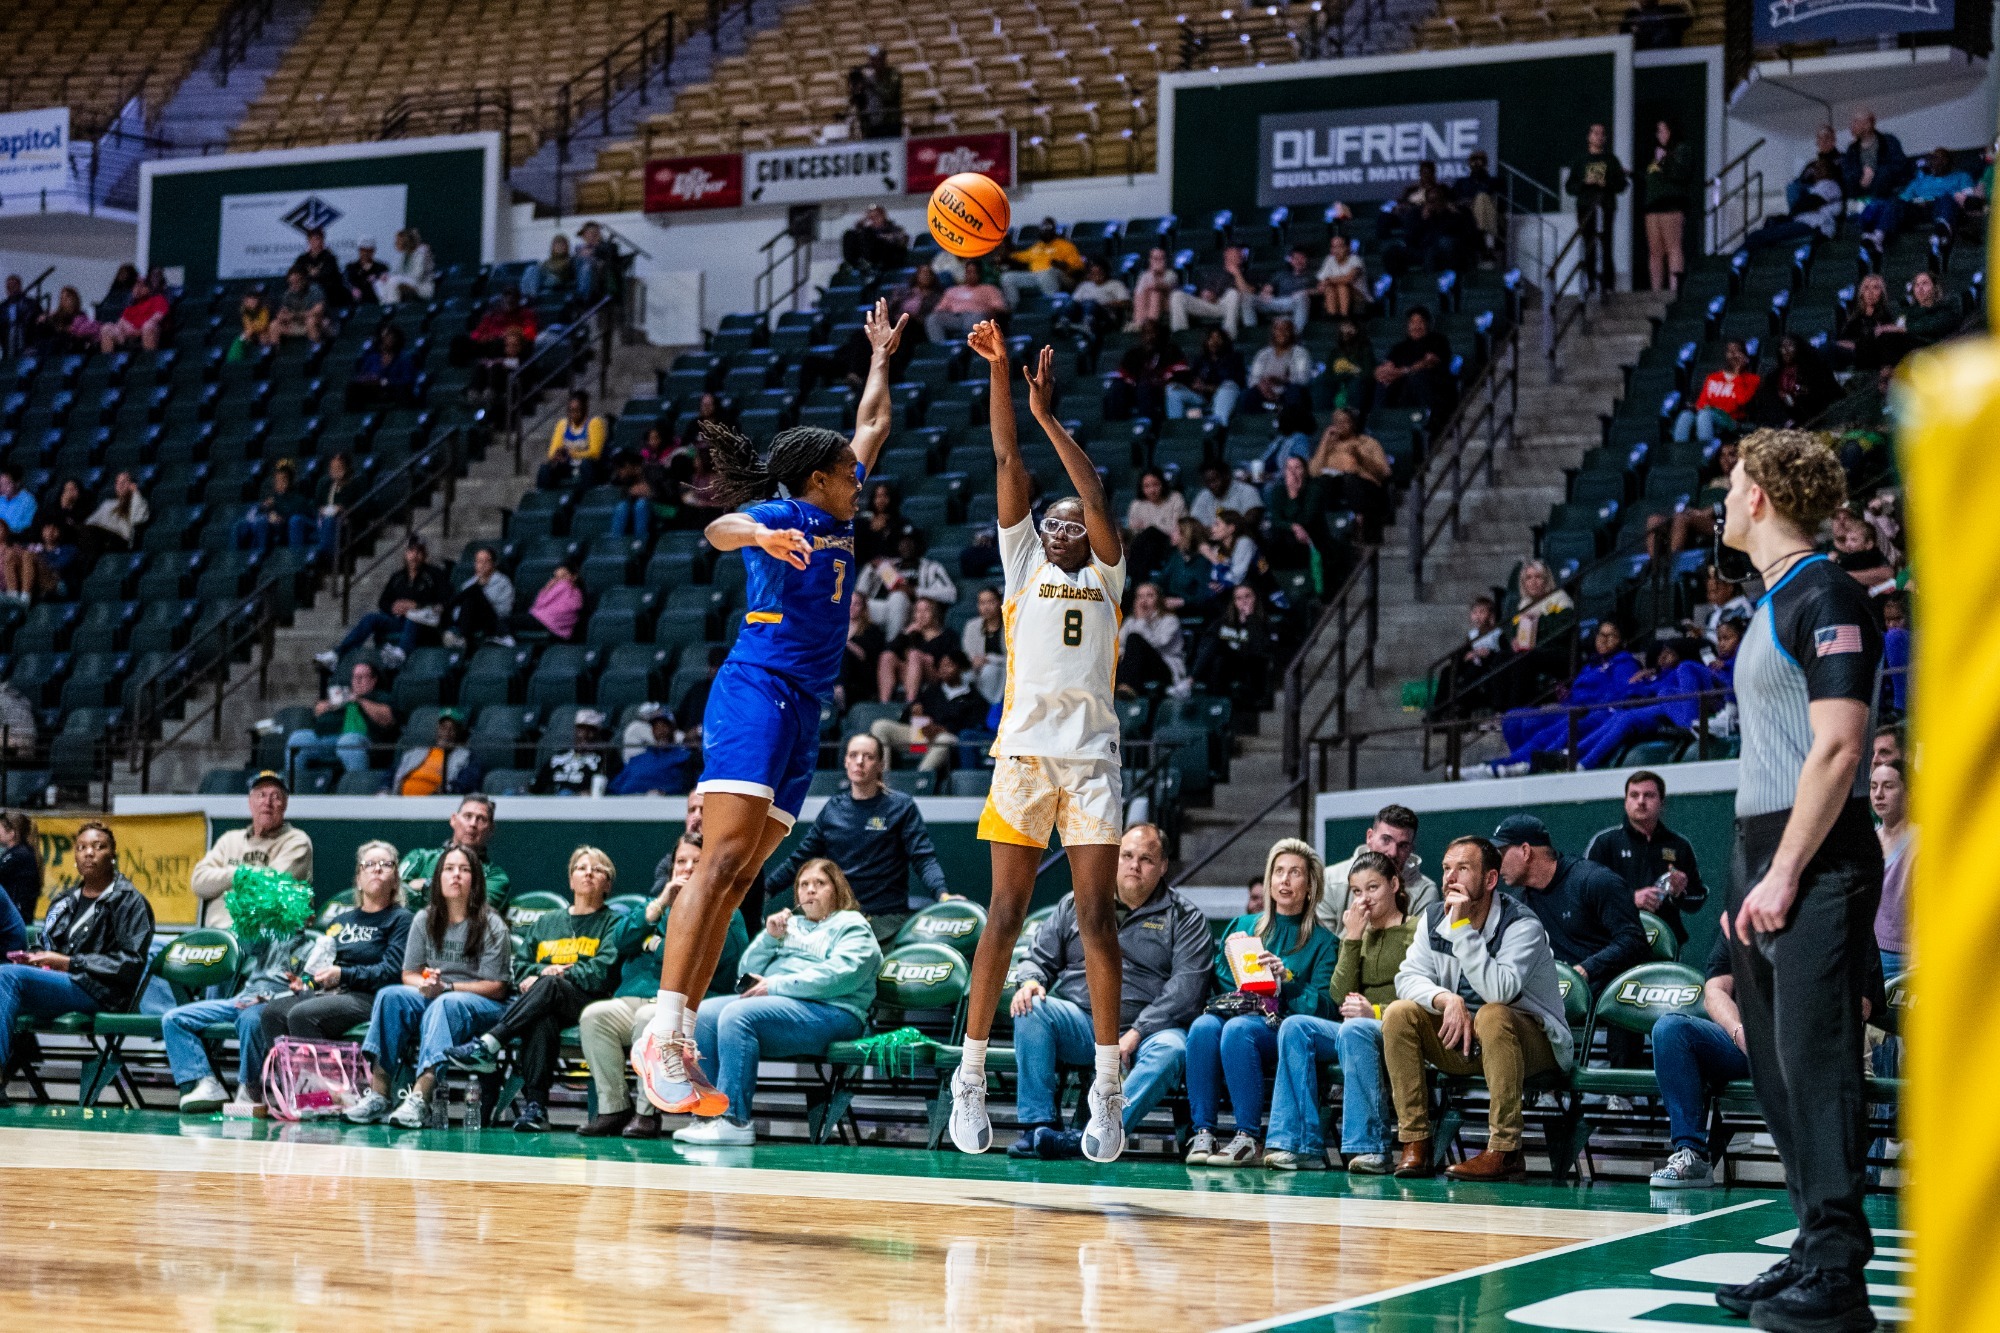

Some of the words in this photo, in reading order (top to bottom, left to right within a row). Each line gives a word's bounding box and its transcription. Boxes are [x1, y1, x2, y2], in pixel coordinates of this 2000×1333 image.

[1273, 118, 1480, 169] DUFRENE
[757, 151, 891, 184] CONCESSIONS
[1272, 168, 1364, 189] BUILDING
[939, 189, 984, 232] Wilson
[932, 215, 965, 245] NCAA
[831, 558, 847, 604] 7
[1063, 608, 1083, 647] 8
[913, 916, 977, 937] Lions
[167, 943, 227, 965] Lions
[882, 962, 951, 983] Lions
[1618, 982, 1701, 1006] Lions
